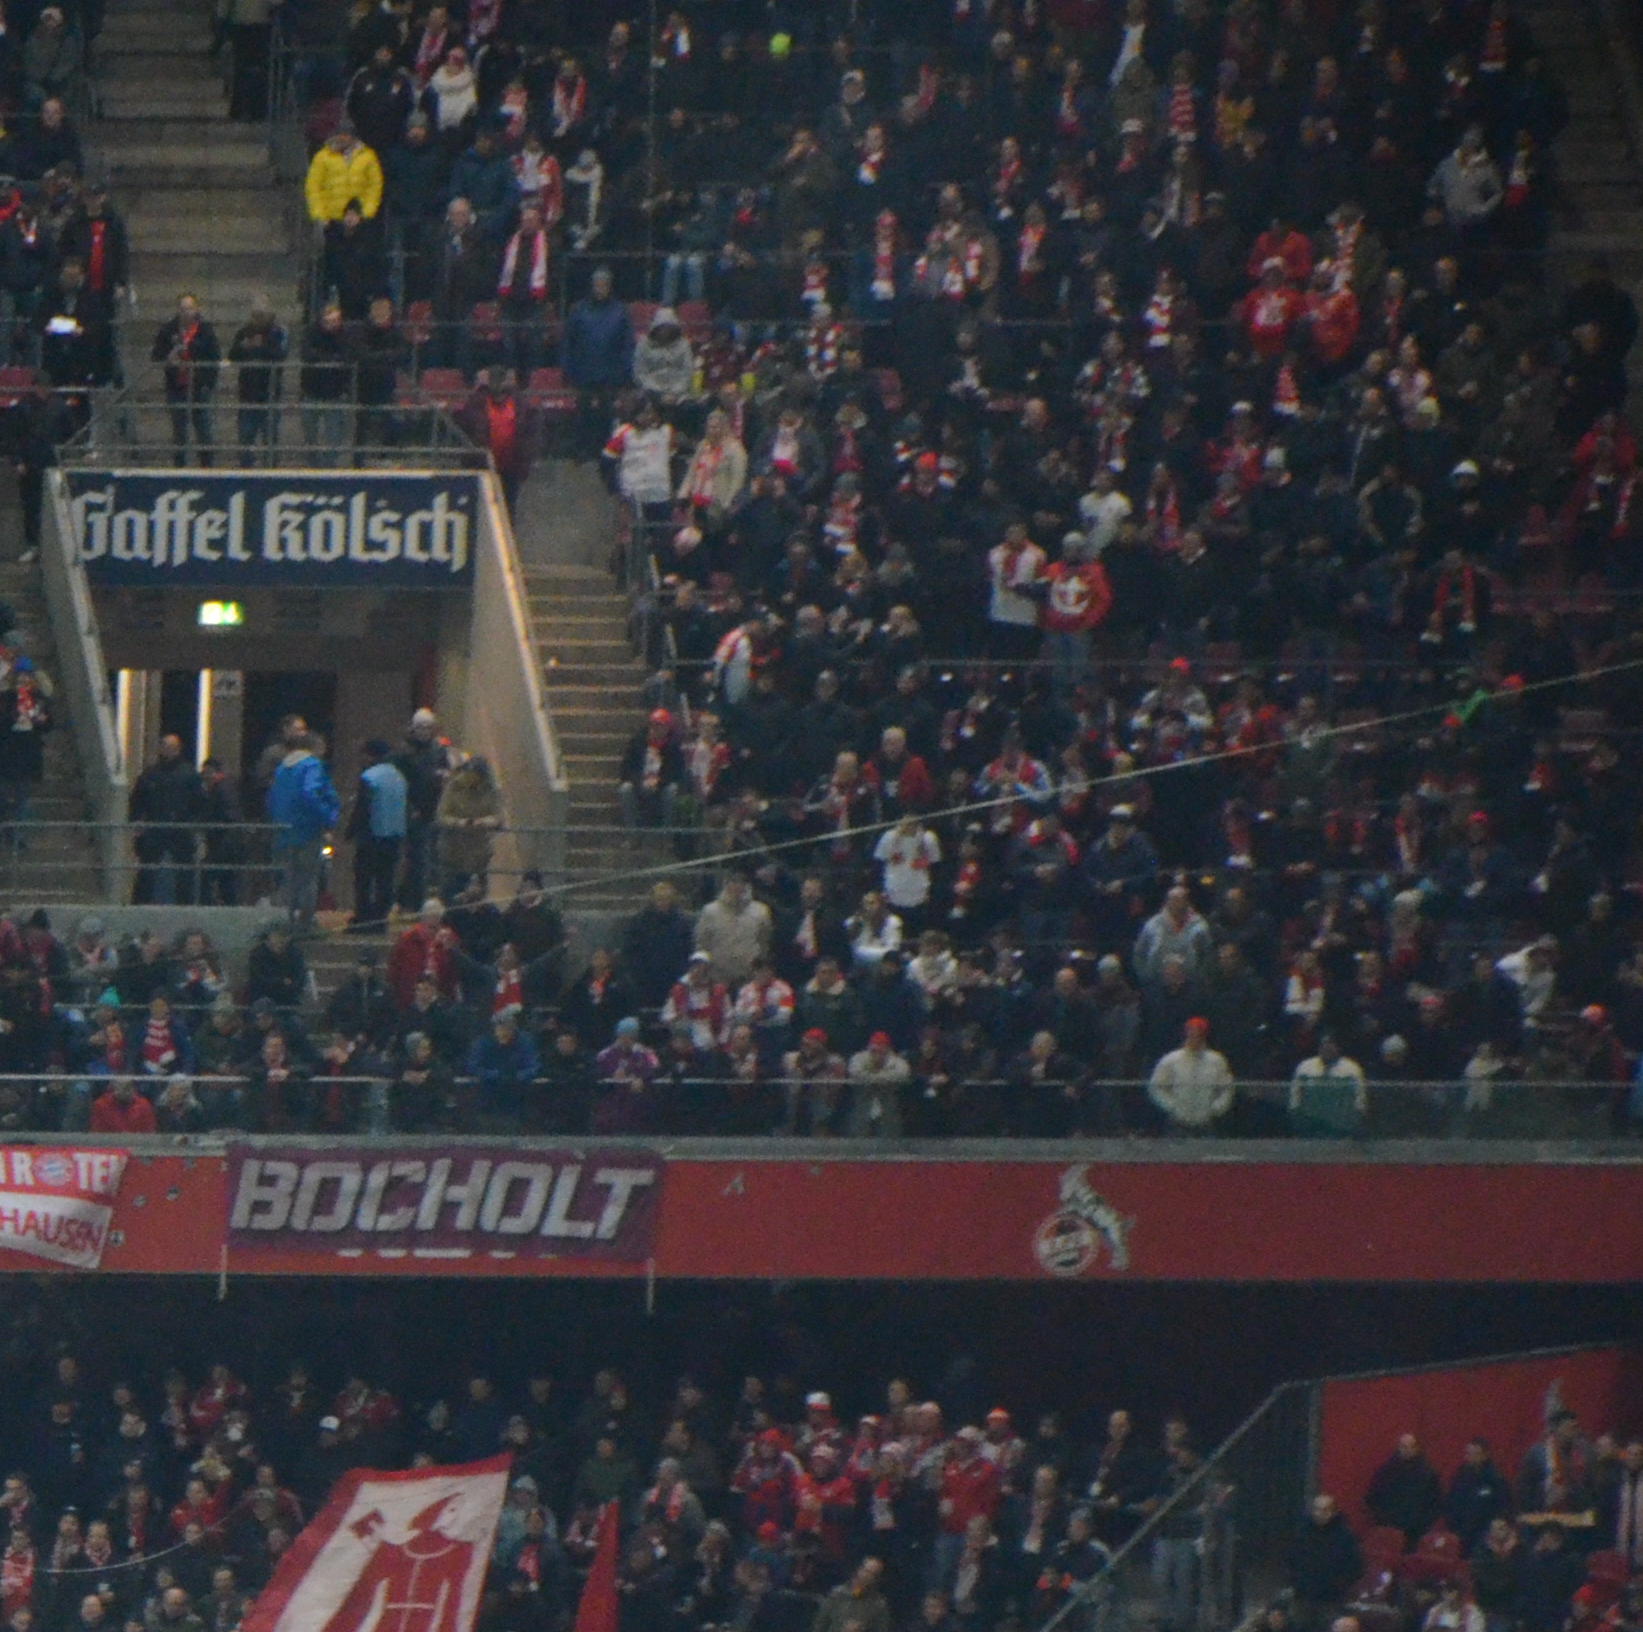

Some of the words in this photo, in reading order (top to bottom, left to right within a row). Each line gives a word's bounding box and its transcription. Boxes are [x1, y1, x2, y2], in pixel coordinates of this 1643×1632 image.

[71, 486, 251, 568] Gaffel
[262, 490, 469, 573] Kölsch
[229, 1157, 656, 1240] BOCHOLT
